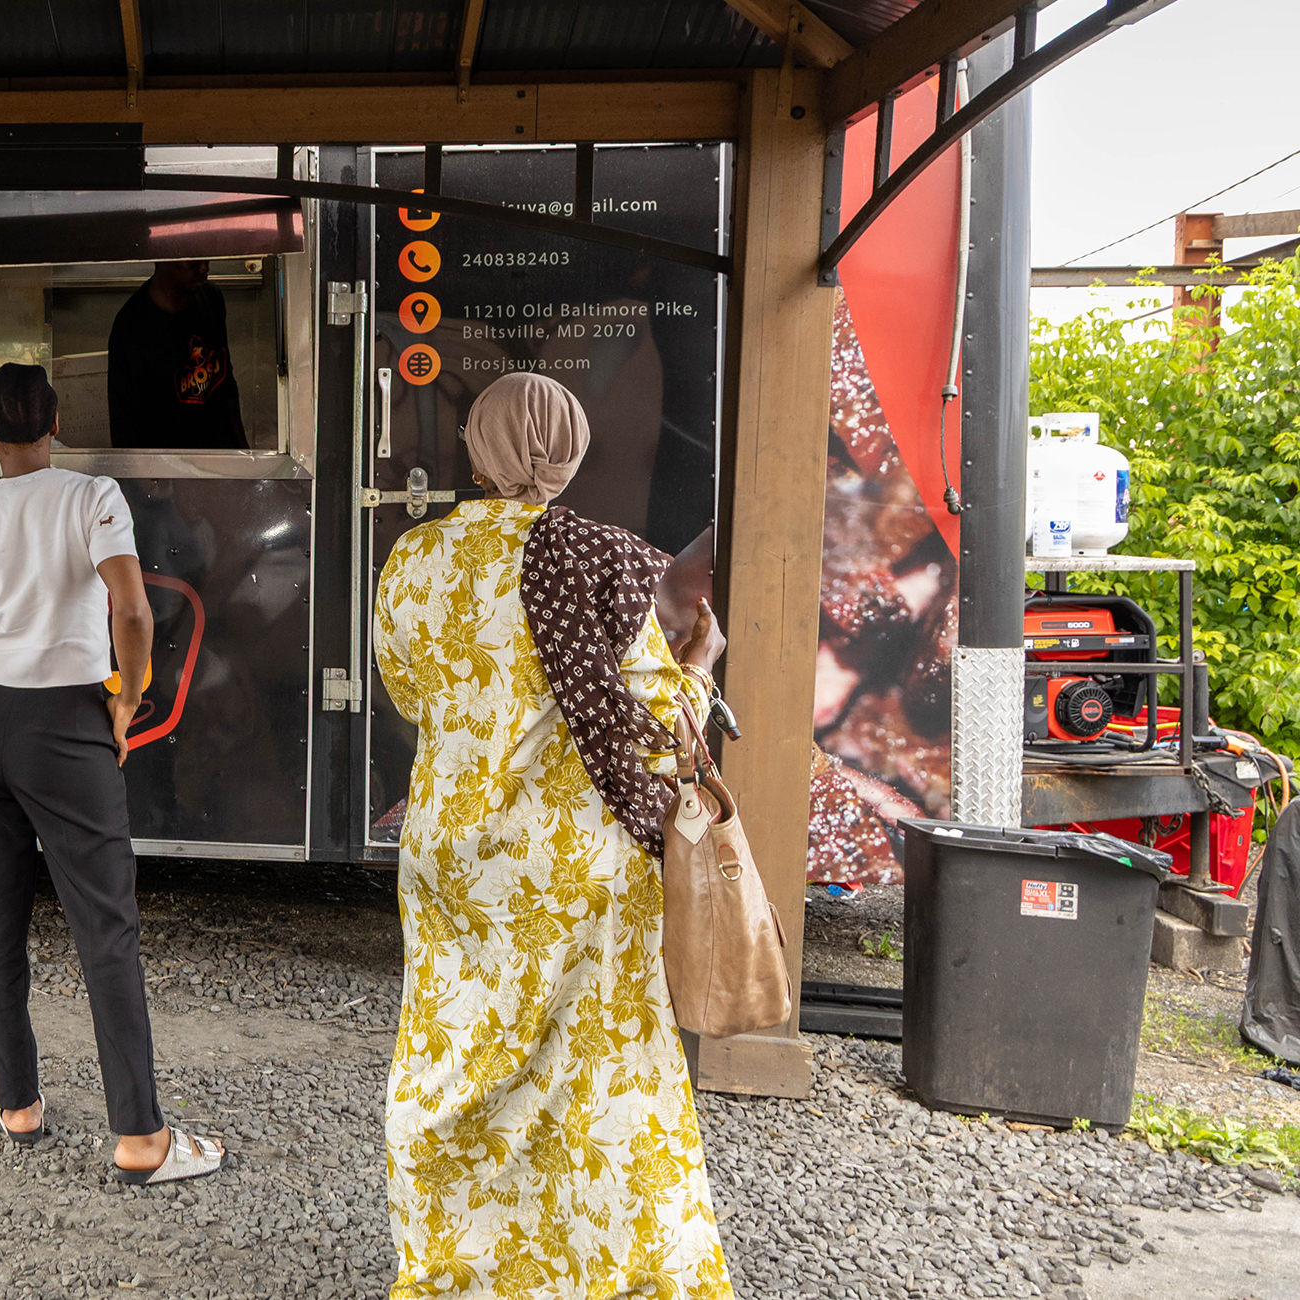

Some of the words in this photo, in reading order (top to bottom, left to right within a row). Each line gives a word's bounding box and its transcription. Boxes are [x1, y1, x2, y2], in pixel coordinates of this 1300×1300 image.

[462, 251, 570, 267] 2408382403
[463, 304, 516, 319] 11210
[522, 303, 553, 318] Old
[560, 302, 648, 317] Baltimore
[655, 302, 698, 317] Pike,
[463, 325, 550, 341] Beltsville,
[557, 324, 586, 338] MD
[593, 324, 636, 338] 2070
[462, 356, 591, 374] Brosjsuya.com
[1027, 882, 1047, 890] Hefty
